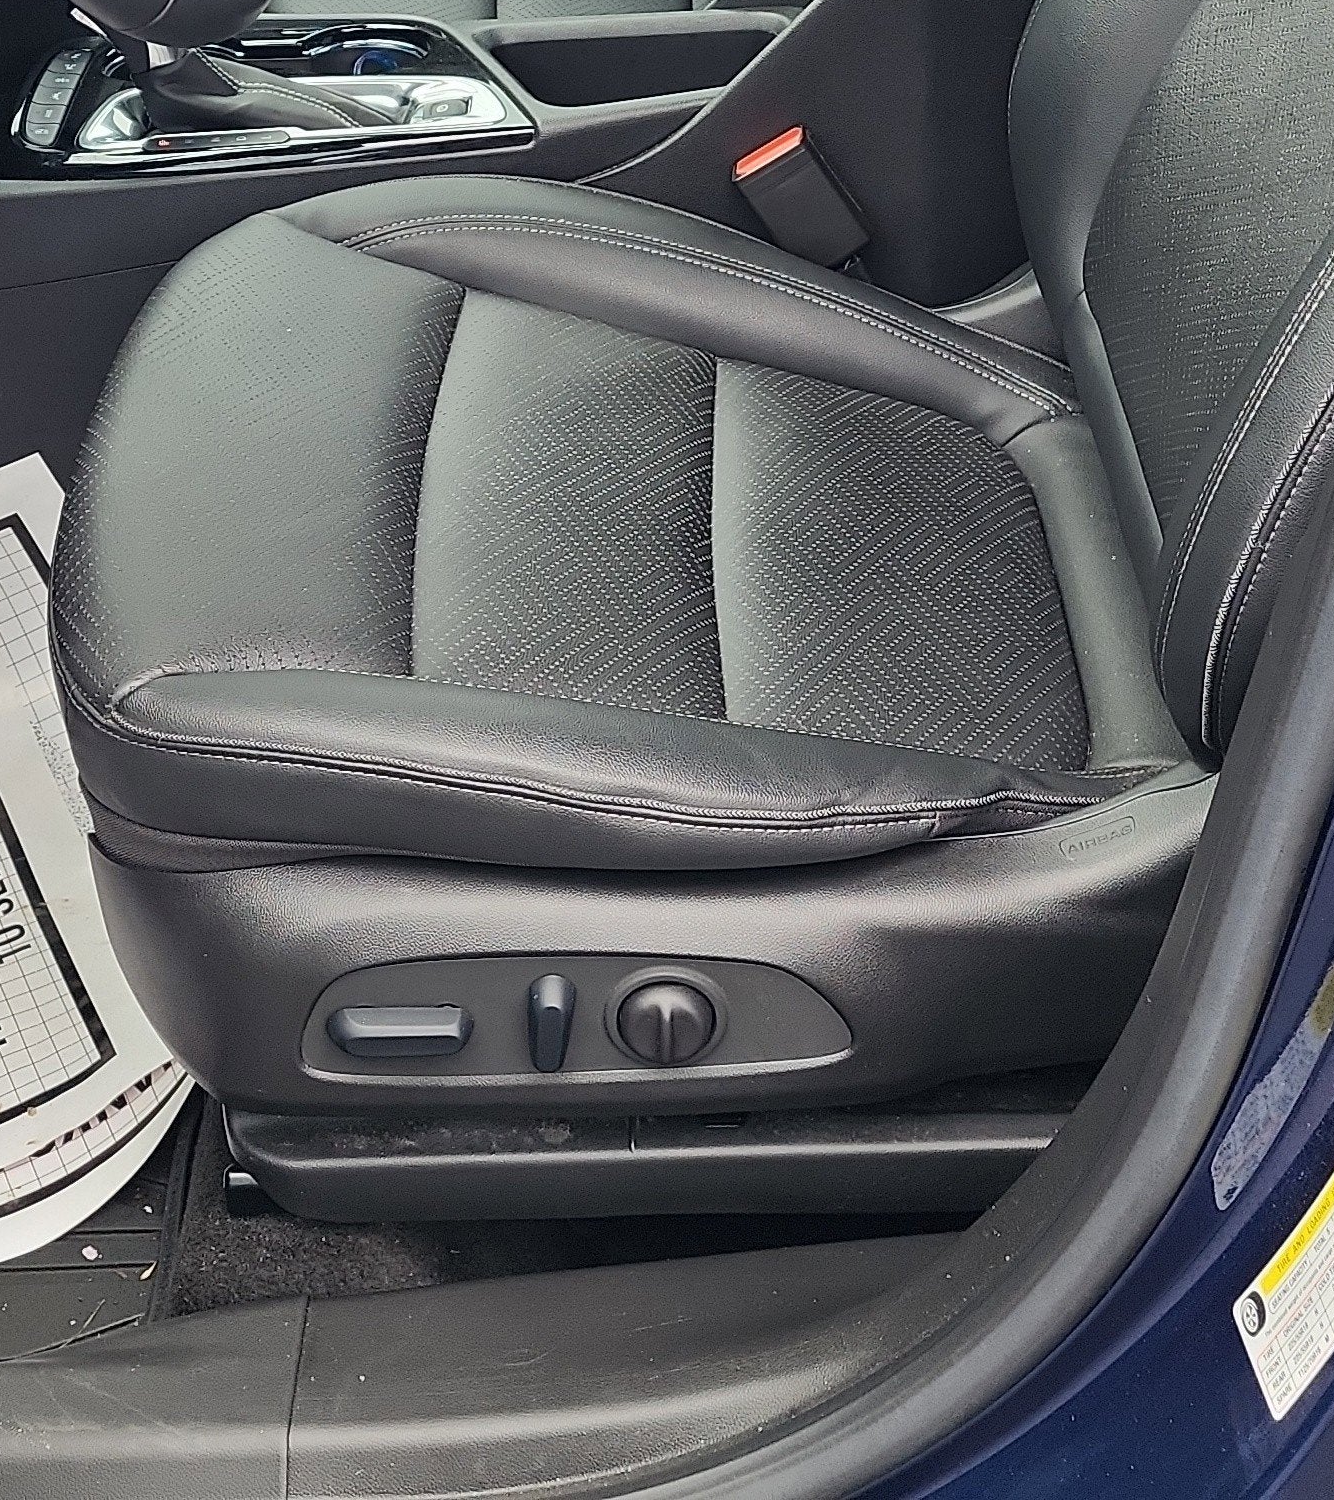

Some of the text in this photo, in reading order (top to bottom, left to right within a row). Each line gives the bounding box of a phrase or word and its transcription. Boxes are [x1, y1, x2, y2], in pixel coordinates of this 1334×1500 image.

[1067, 824, 1134, 855] AIRBAG
[1276, 1252, 1292, 1273] TIRE
[1292, 1235, 1306, 1254] AND
[1306, 1197, 1331, 1233] LOADING
[1265, 1356, 1283, 1378] FRONT
